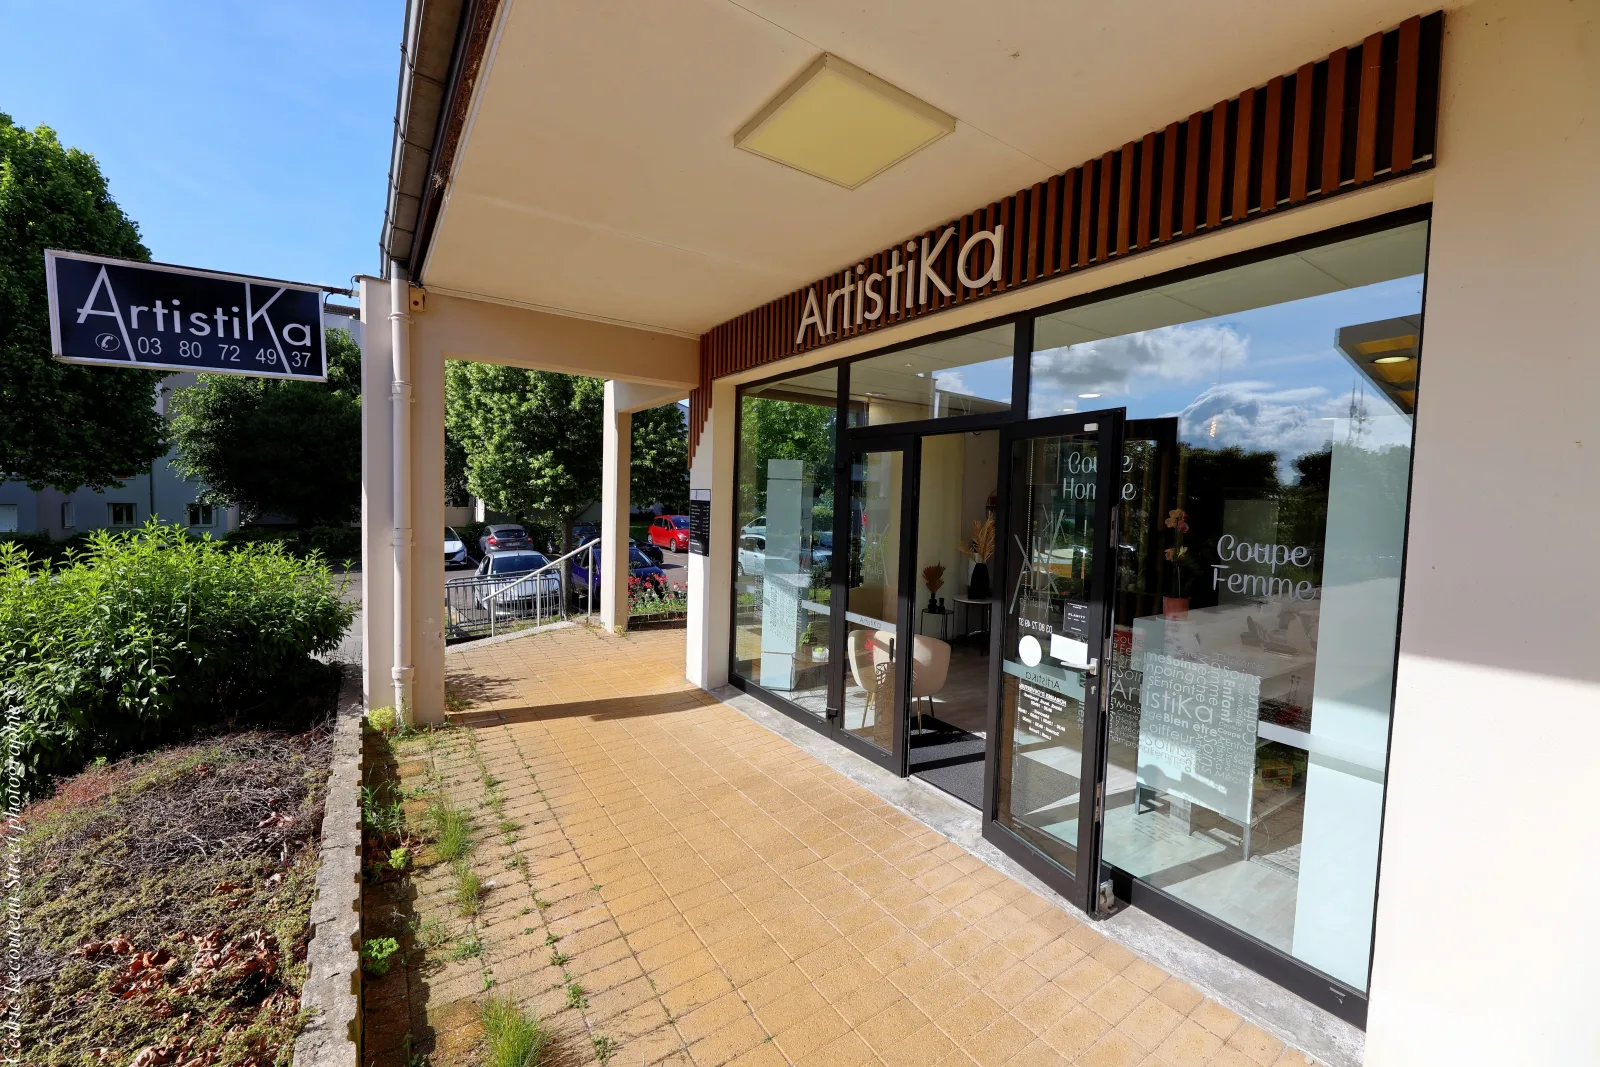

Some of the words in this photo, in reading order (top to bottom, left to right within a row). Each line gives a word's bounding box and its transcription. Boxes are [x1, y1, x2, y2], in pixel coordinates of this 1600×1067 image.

[797, 224, 1004, 344] ArtistiKa
[77, 265, 312, 374] ArtistiKa
[137, 336, 162, 355] 03
[179, 340, 202, 359] 80
[218, 344, 241, 362] 72
[255, 347, 277, 365] 49
[291, 351, 312, 368] 37
[1217, 534, 1312, 574] Coupe
[1211, 564, 1317, 601] Femme
[1163, 712, 1189, 729] Bien
